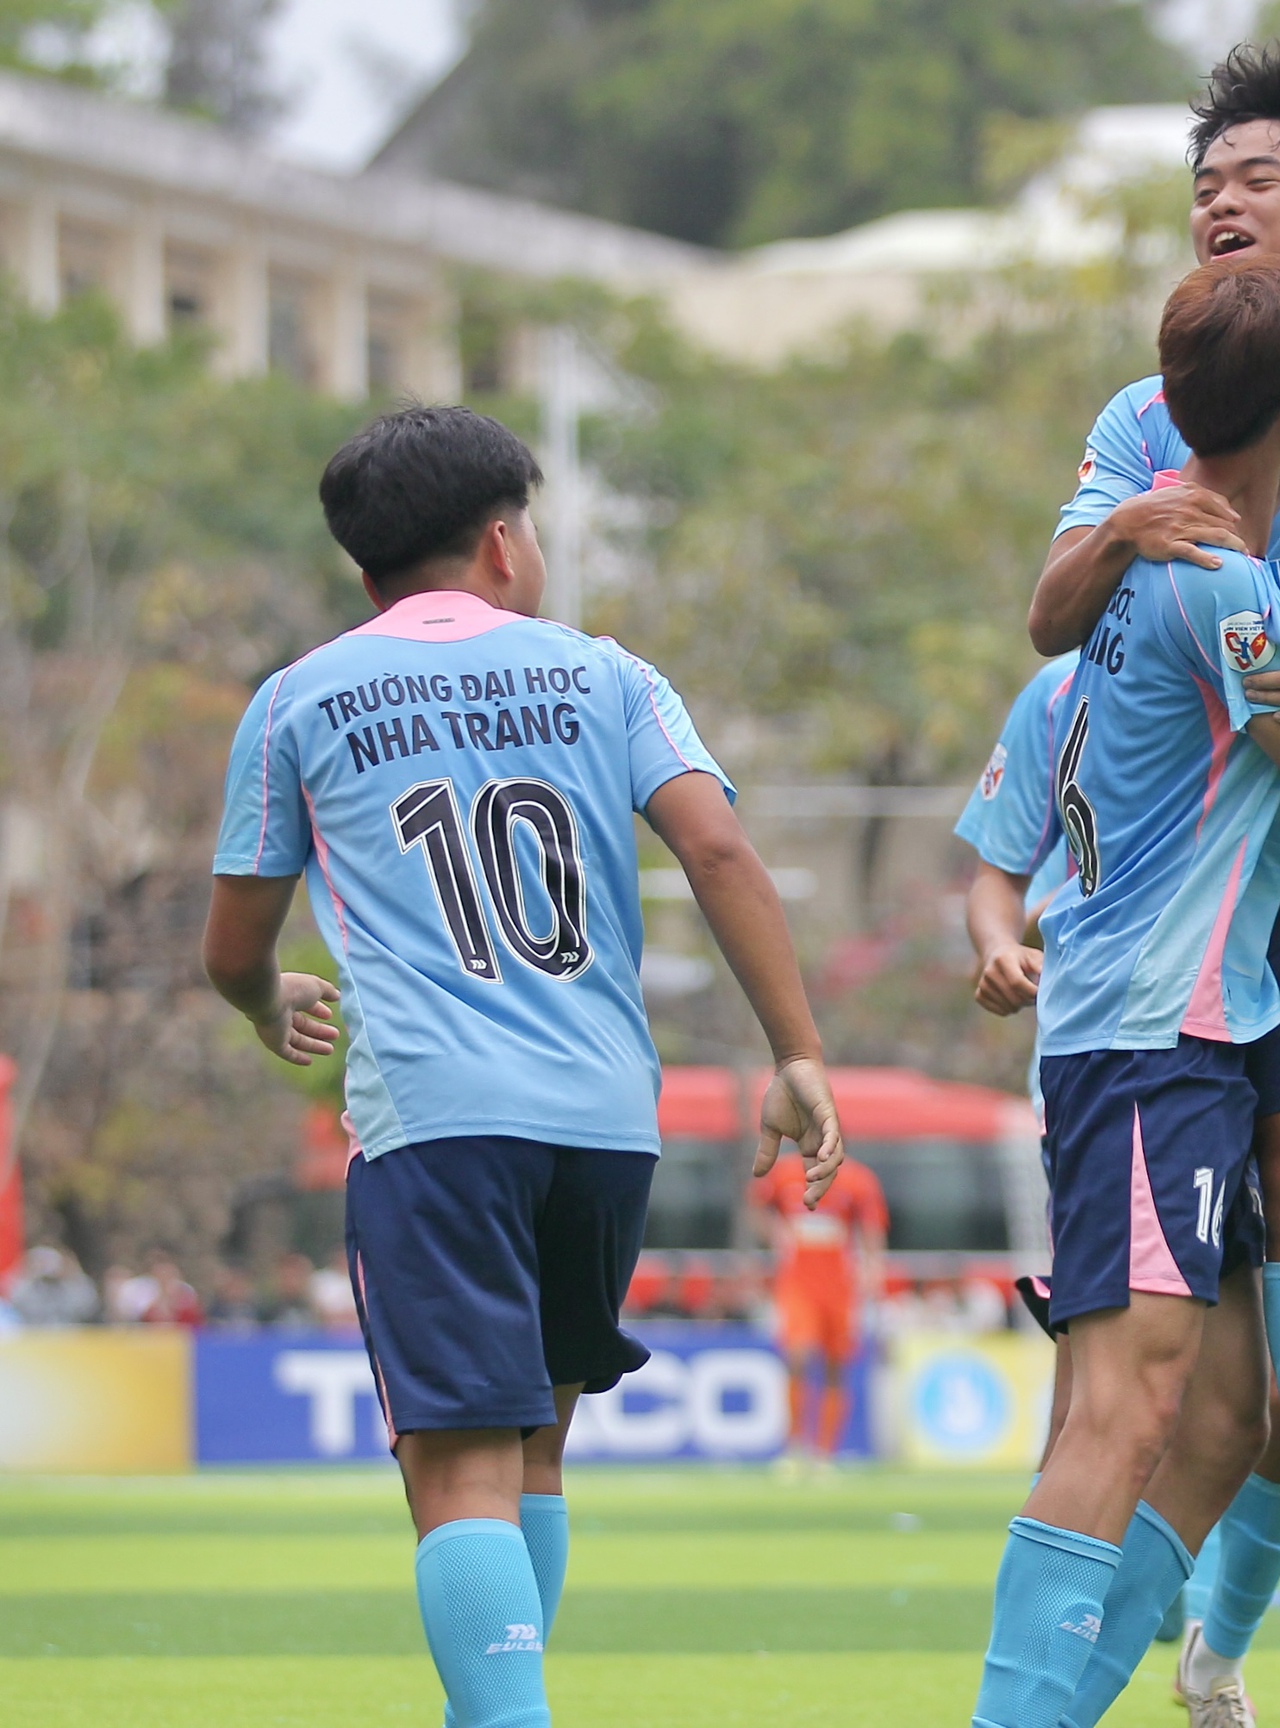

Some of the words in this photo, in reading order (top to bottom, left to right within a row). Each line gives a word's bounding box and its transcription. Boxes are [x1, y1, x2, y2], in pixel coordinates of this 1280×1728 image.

[318, 672, 452, 731] TRƯỜNG
[460, 669, 517, 706] ĐẠI
[523, 666, 591, 699] HỌC
[346, 714, 440, 774] NHA
[441, 703, 580, 751] TRANG
[389, 776, 595, 984] 10
[274, 1350, 789, 1456] TCO
